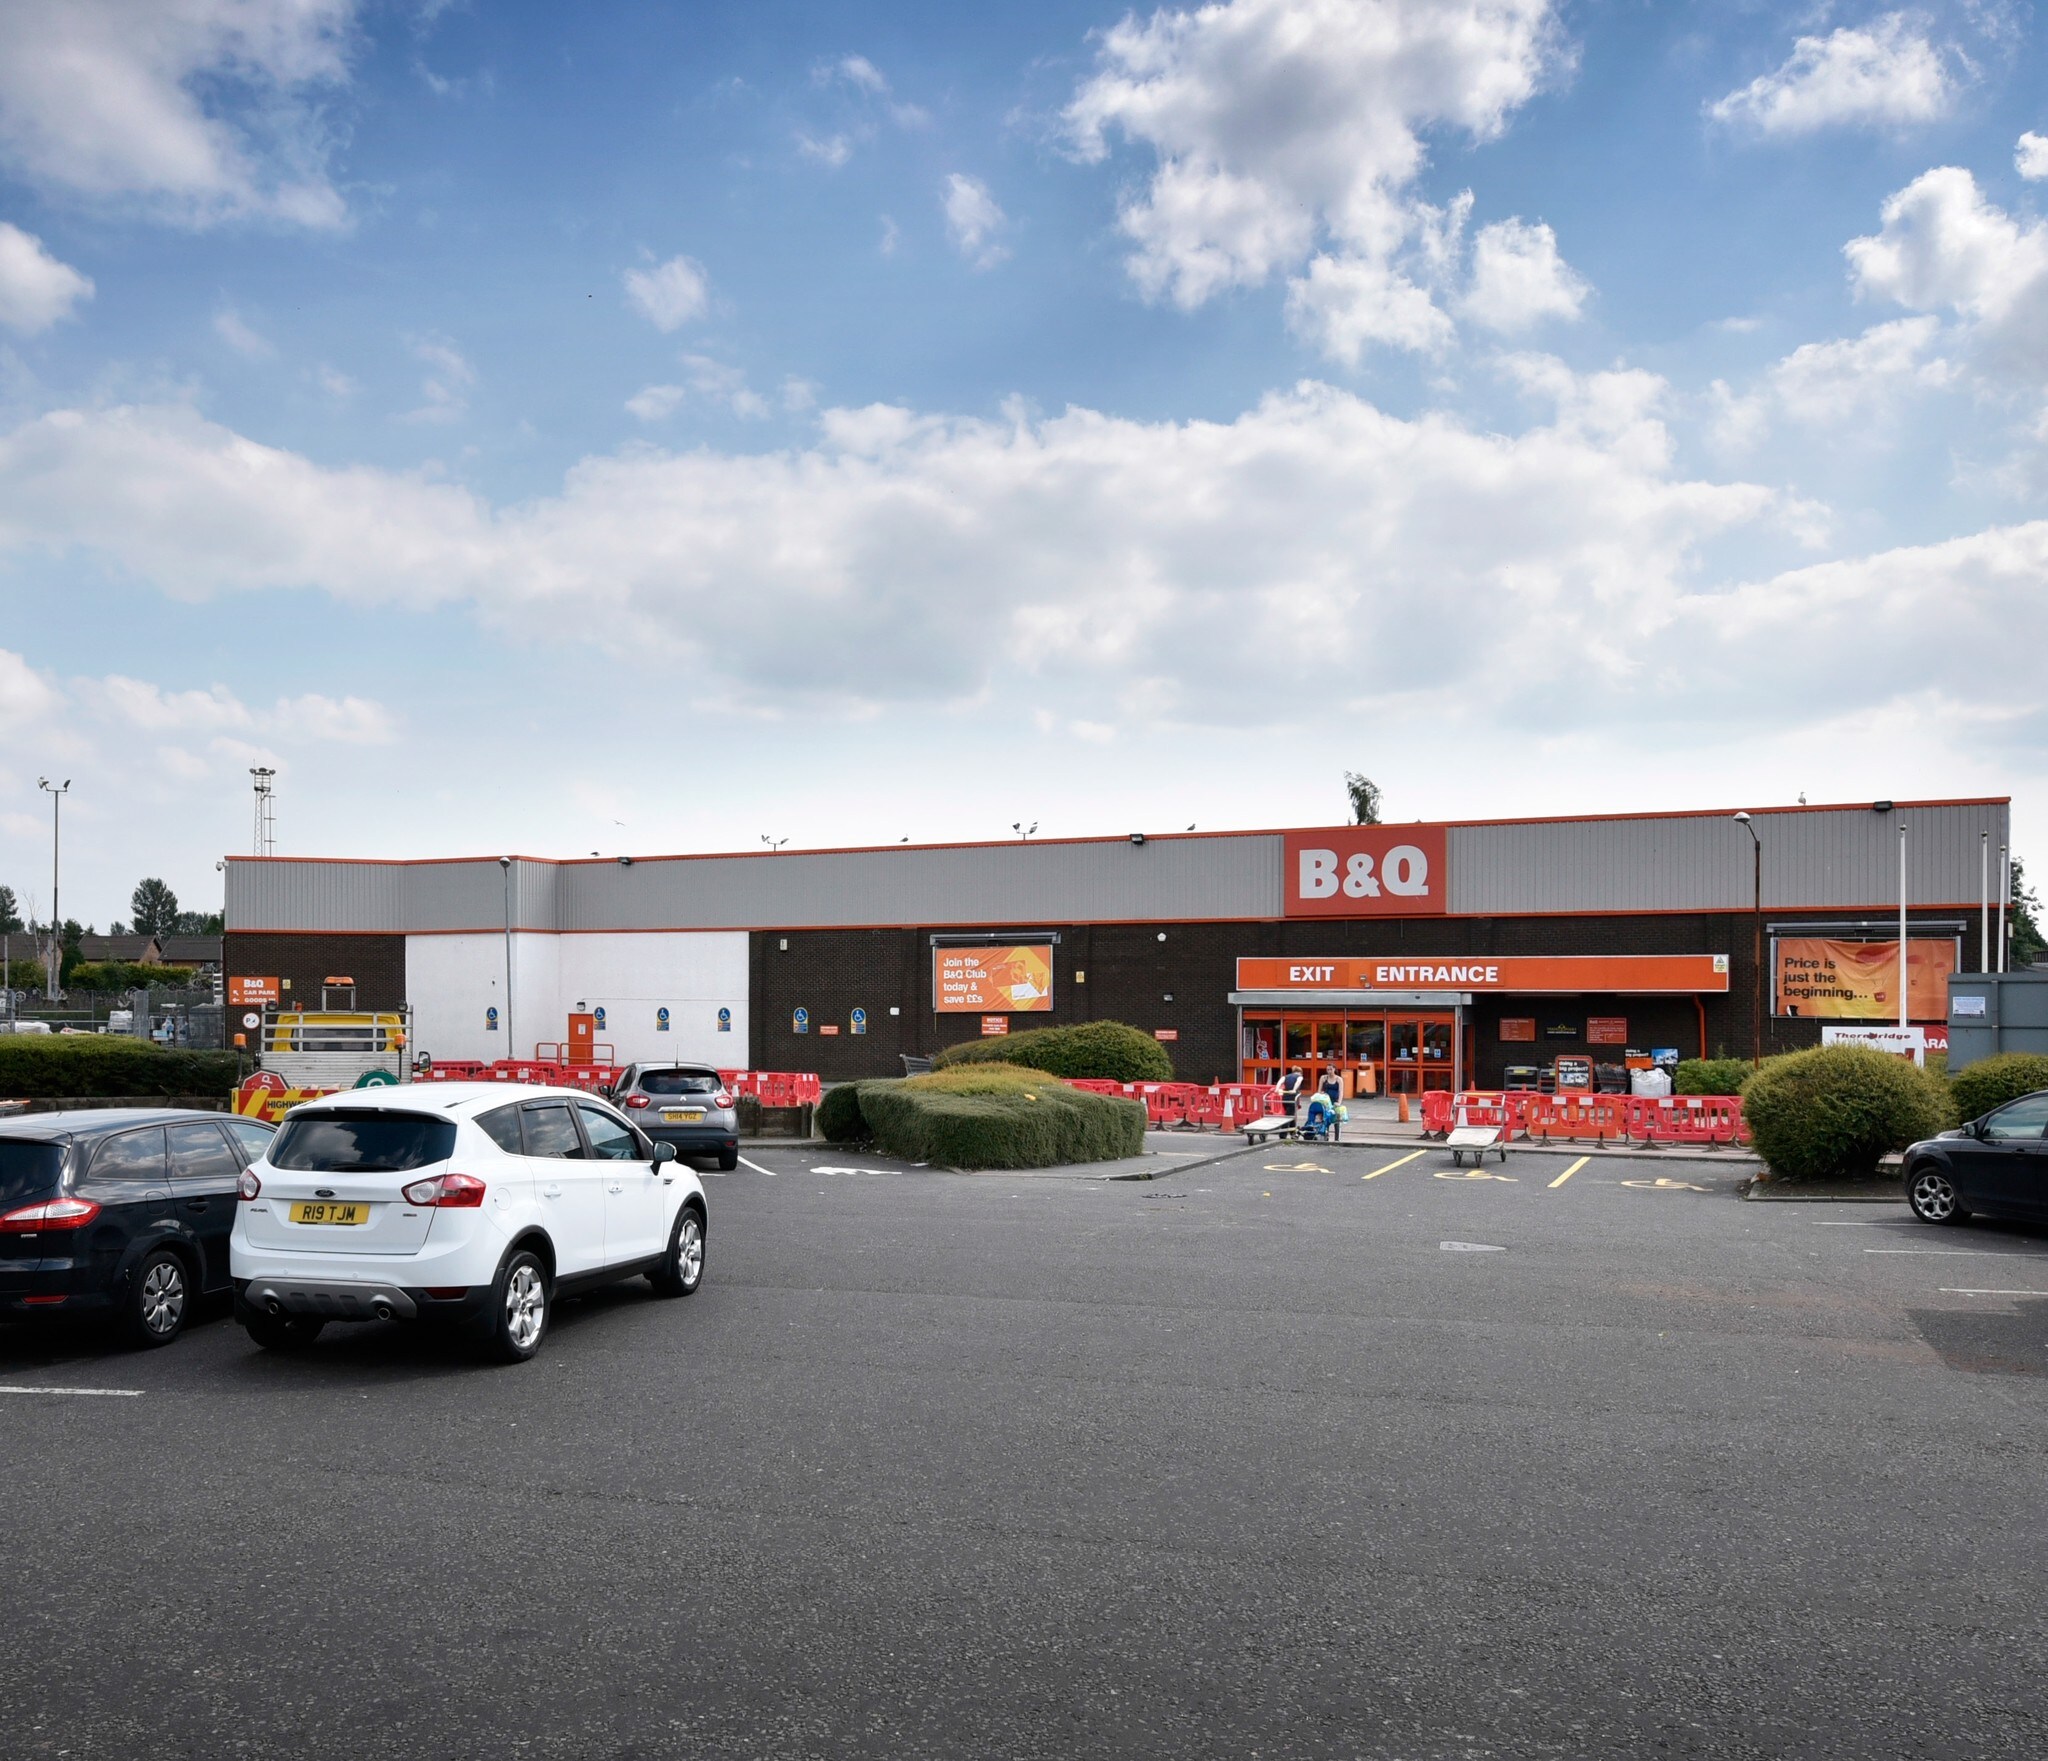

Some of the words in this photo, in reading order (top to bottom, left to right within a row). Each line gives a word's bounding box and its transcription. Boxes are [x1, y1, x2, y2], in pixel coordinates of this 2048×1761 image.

[1299, 845, 1428, 898] B&Q
[943, 958, 962, 967] Join
[964, 957, 979, 966] the
[1784, 957, 1819, 968] Price
[1824, 958, 1836, 969] is
[943, 970, 963, 979] B&Q
[966, 969, 987, 978] Club
[1289, 966, 1335, 982] EXIT
[1376, 966, 1498, 982] ENTRANCE
[1783, 972, 1809, 984] just
[1814, 972, 1836, 983] the
[243, 979, 264, 988] B&Q
[943, 982, 968, 993] today
[970, 982, 978, 991] &
[1783, 986, 1868, 1000] beginning...
[943, 996, 964, 1004] save
[302, 1206, 323, 1219] R19
[329, 1207, 356, 1221] TJM
